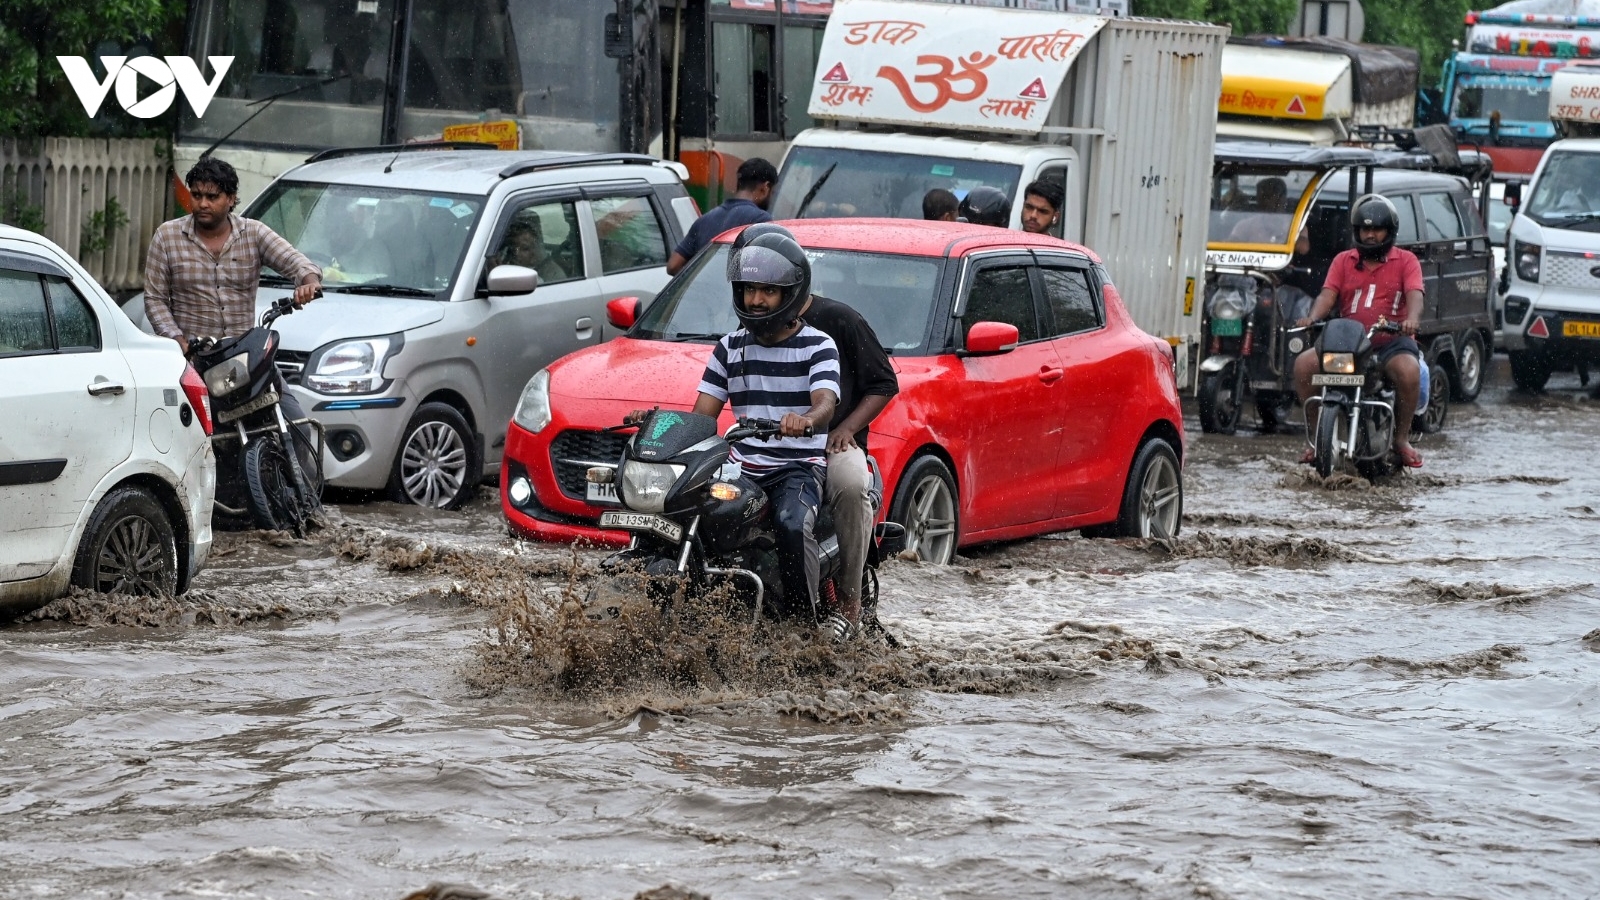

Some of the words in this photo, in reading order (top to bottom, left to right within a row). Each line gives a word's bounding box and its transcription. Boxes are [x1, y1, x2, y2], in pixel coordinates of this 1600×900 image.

[843, 20, 926, 46] डाक
[998, 28, 1085, 62] पार्सल
[876, 51, 997, 113] ॐ
[1571, 86, 1600, 99] SHR
[1228, 254, 1266, 265] BHARAT
[611, 514, 623, 525] DL
